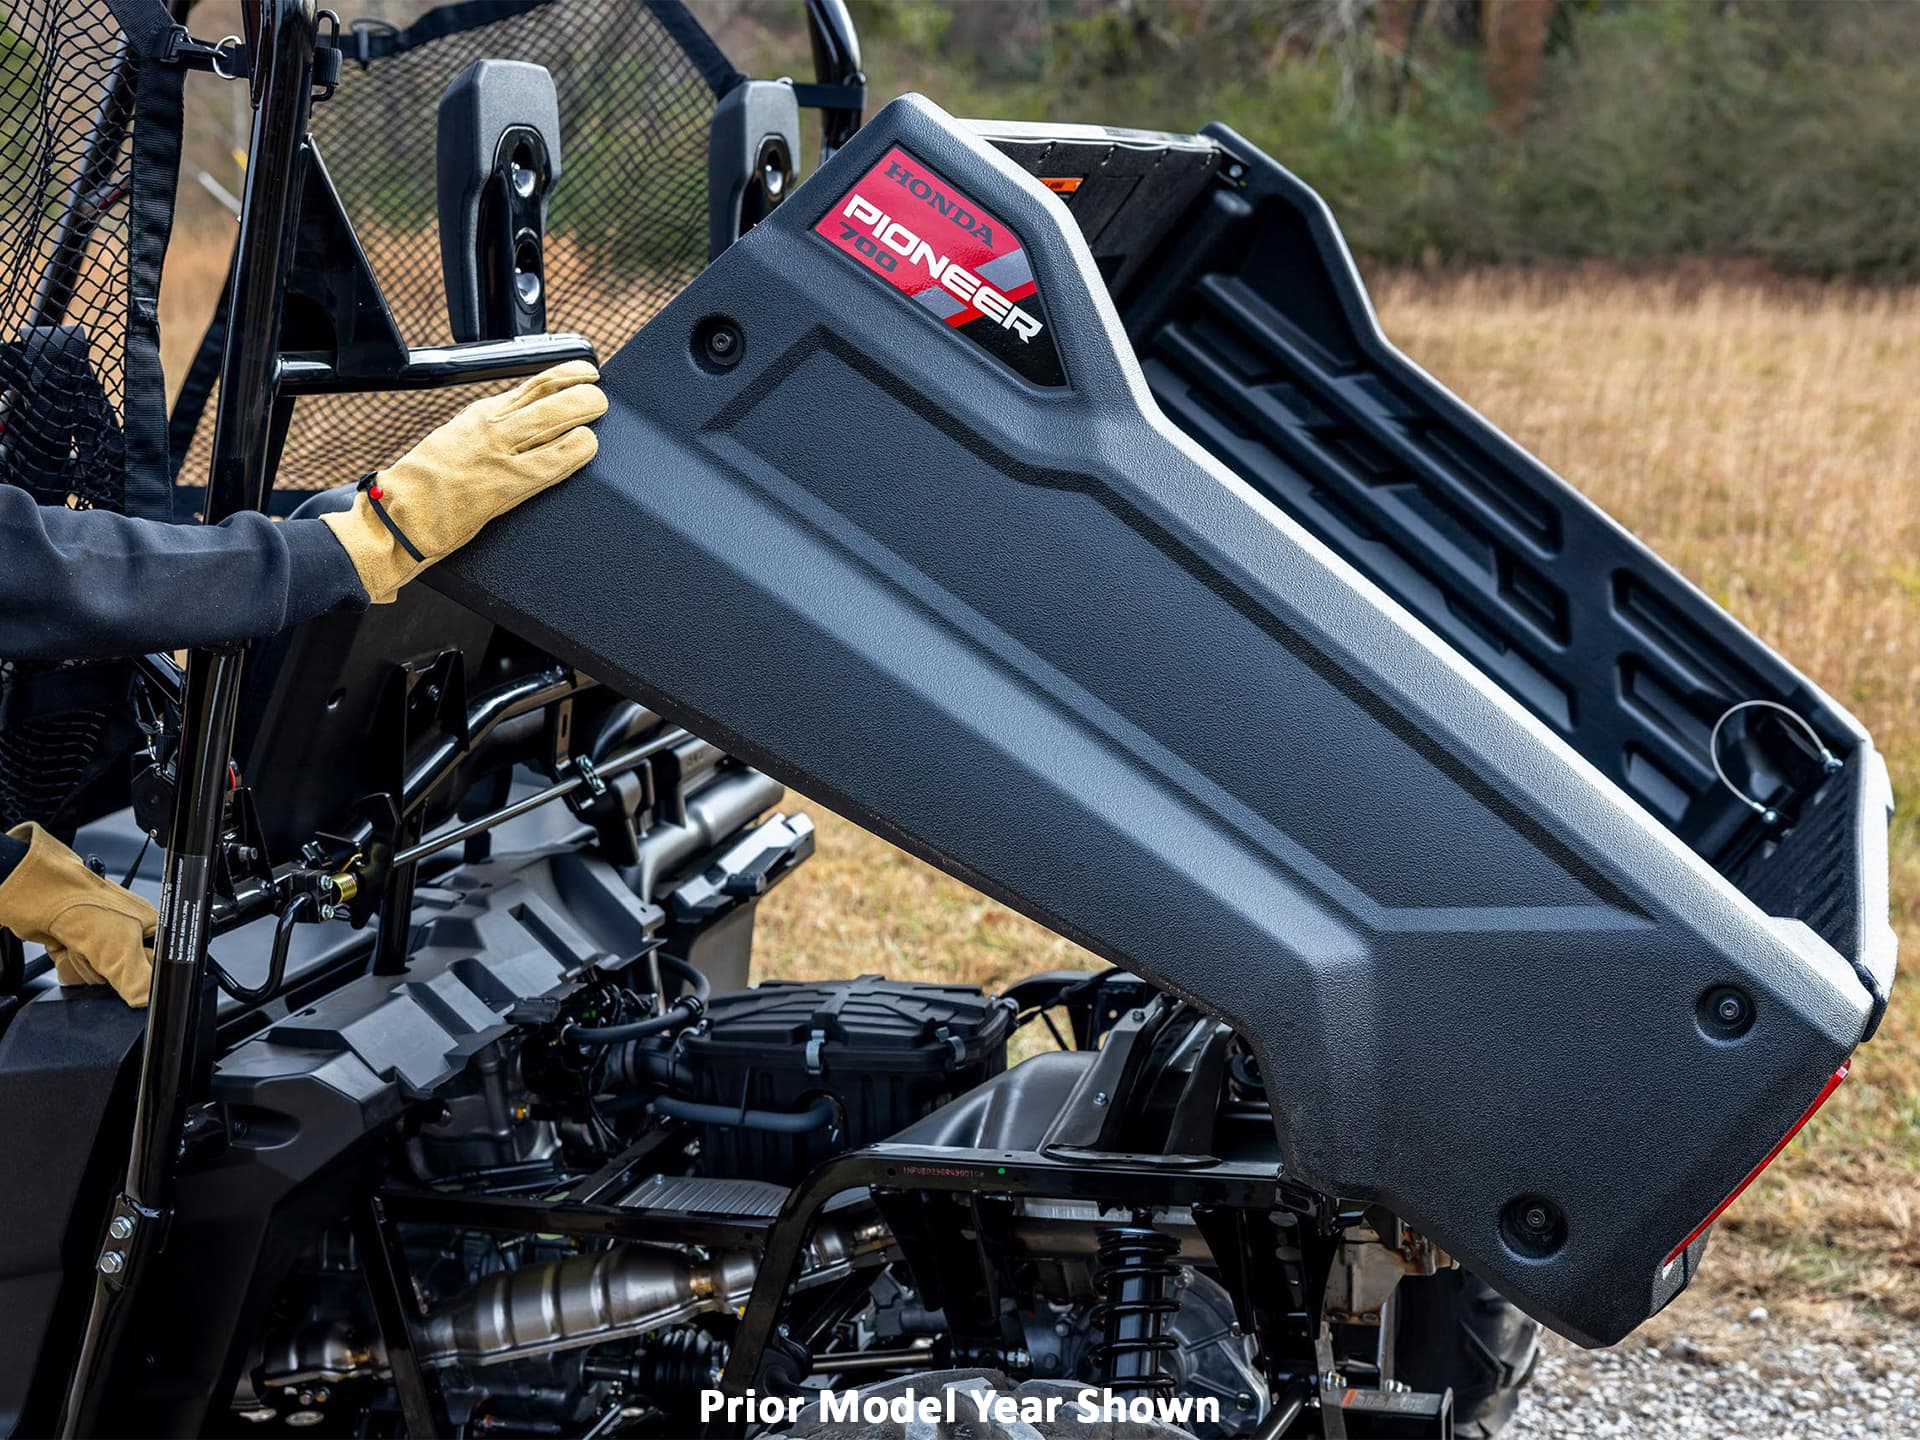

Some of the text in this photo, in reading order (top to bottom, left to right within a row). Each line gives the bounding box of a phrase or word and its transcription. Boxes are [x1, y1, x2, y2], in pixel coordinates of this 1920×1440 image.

[838, 221, 898, 273] 700
[883, 160, 994, 248] HONDA
[842, 193, 1044, 344] PIONEER
